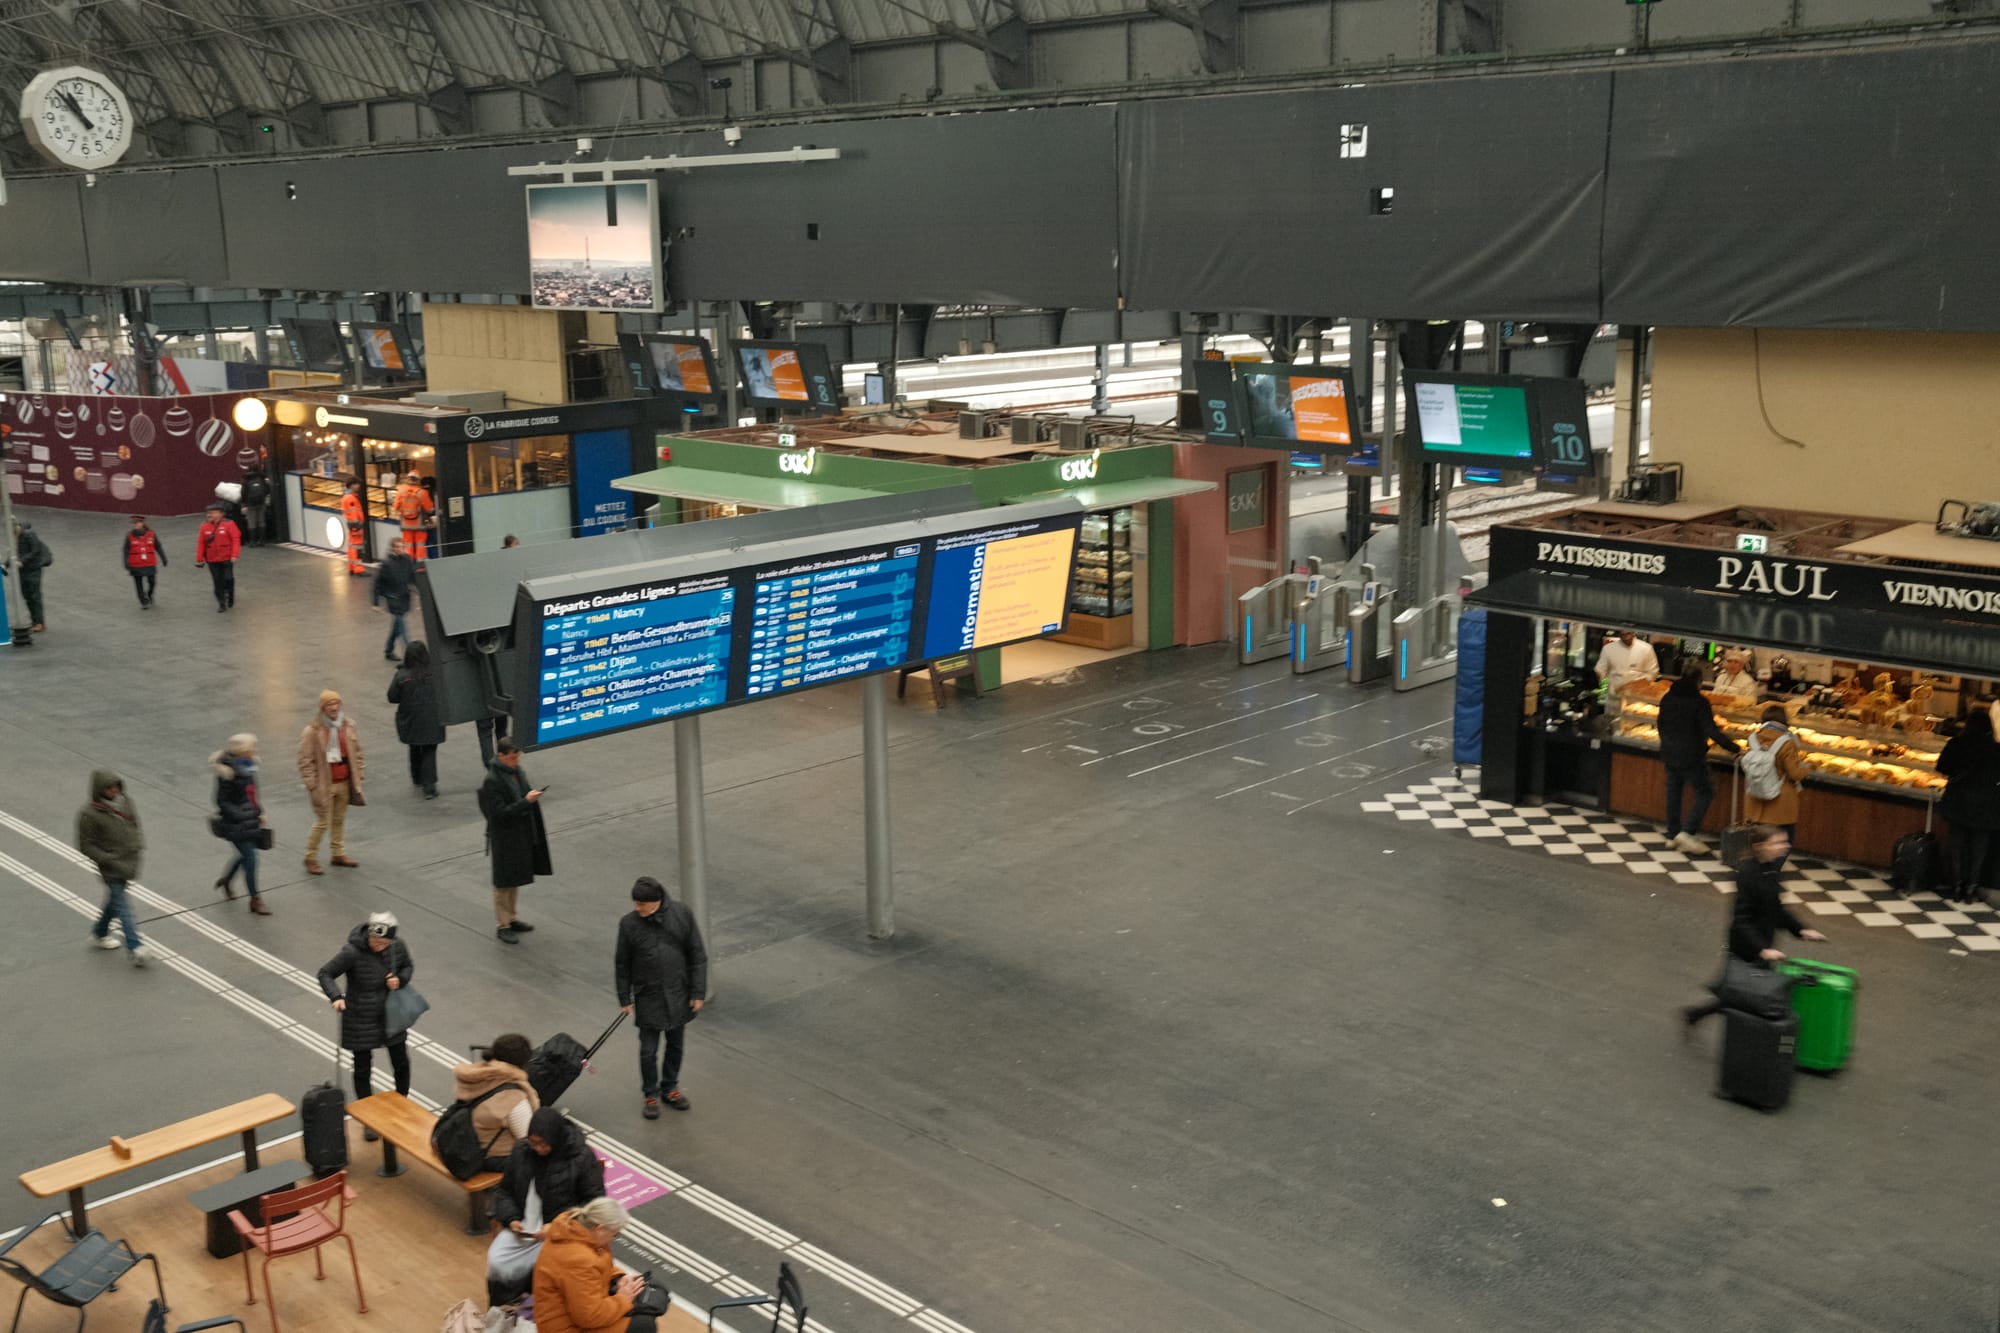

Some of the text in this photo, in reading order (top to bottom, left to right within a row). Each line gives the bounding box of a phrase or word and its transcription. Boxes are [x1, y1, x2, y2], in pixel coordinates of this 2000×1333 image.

[73, 82, 83, 95] 12
[90, 86, 95, 98] 1
[49, 96, 60, 109] 10
[101, 99, 110, 110] 2
[46, 112, 55, 124] 9
[110, 114, 117, 126] 3
[54, 127, 63, 140] 8
[105, 129, 114, 140] 4
[66, 139, 75, 153] 7
[81, 143, 90, 155] 6
[95, 140, 103, 152] 5
[818, 384, 829, 402] 8
[485, 415, 560, 430] LA FABRIQUE COOKIES
[1213, 411, 1226, 431] 9
[1551, 435, 1584, 460] 10
[594, 501, 626, 512] METTEZ
[597, 513, 627, 524] COOKIE
[1537, 542, 1666, 575] PATISSERIES
[814, 571, 847, 582] Frankfurt
[848, 566, 866, 576] Main
[866, 563, 880, 573] Hbf
[1715, 556, 1838, 600] PAUL
[813, 580, 858, 594] Luxembourg
[543, 586, 676, 616] Départs Grandes Lignes
[812, 594, 837, 605] Belfort
[960, 545, 985, 650] Information
[613, 607, 645, 619] Nancy
[810, 605, 838, 617] Colmar
[810, 615, 842, 627] Stuttgart
[843, 610, 857, 620] Hbf
[562, 629, 590, 639] Nancy
[611, 616, 720, 644] Berlin-Gesundbrunnen
[808, 629, 832, 639] Nancy
[807, 628, 888, 649] Châlons-en-Champagne
[597, 646, 613, 657] Hbf
[618, 637, 661, 653] Mannheim
[663, 634, 679, 645] Hbf
[805, 659, 836, 671] Culmont
[841, 651, 878, 663] Chalindrey
[806, 650, 830, 660] Troyes
[609, 656, 637, 668] Dijon
[569, 674, 601, 687] Langres
[608, 665, 643, 679] Culmont
[650, 657, 691, 670] Chalindrey
[608, 663, 716, 691] Châlons-en-Champagne
[803, 669, 837, 682] Frankfurt
[837, 664, 855, 674] Main
[855, 661, 869, 670] Hbf
[570, 697, 605, 710] Epernay
[611, 676, 705, 701] Châlons-en-Champagne
[607, 702, 640, 714] Troyes
